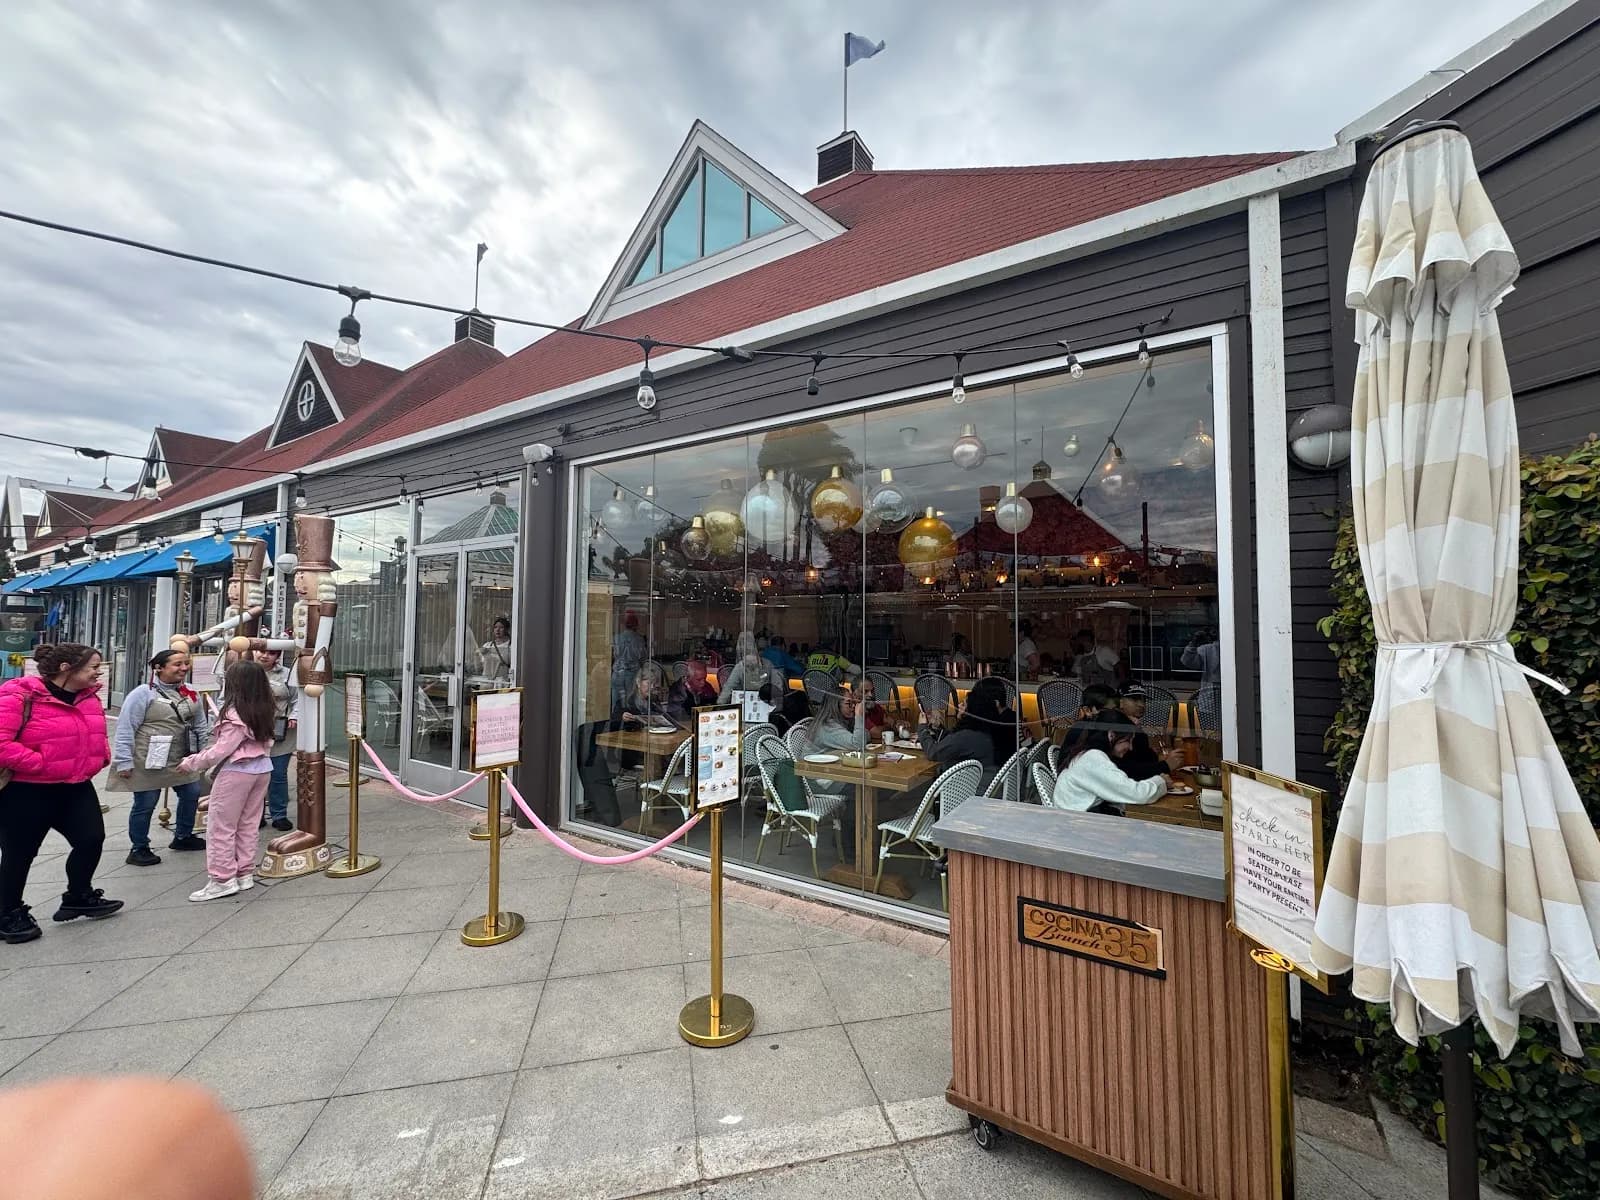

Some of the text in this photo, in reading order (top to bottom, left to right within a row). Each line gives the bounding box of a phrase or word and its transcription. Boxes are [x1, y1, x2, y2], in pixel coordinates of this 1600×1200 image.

[1233, 822, 1312, 864] STARTS HER
[1239, 806, 1280, 833] check
[1284, 830, 1306, 845] in
[1247, 846, 1302, 878] IN ORDER TO BE
[1242, 866, 1311, 906] HAVE YOUR ENTIRE
[1247, 879, 1306, 917] PARTY PRESENT.
[1035, 924, 1101, 950] Brunch
